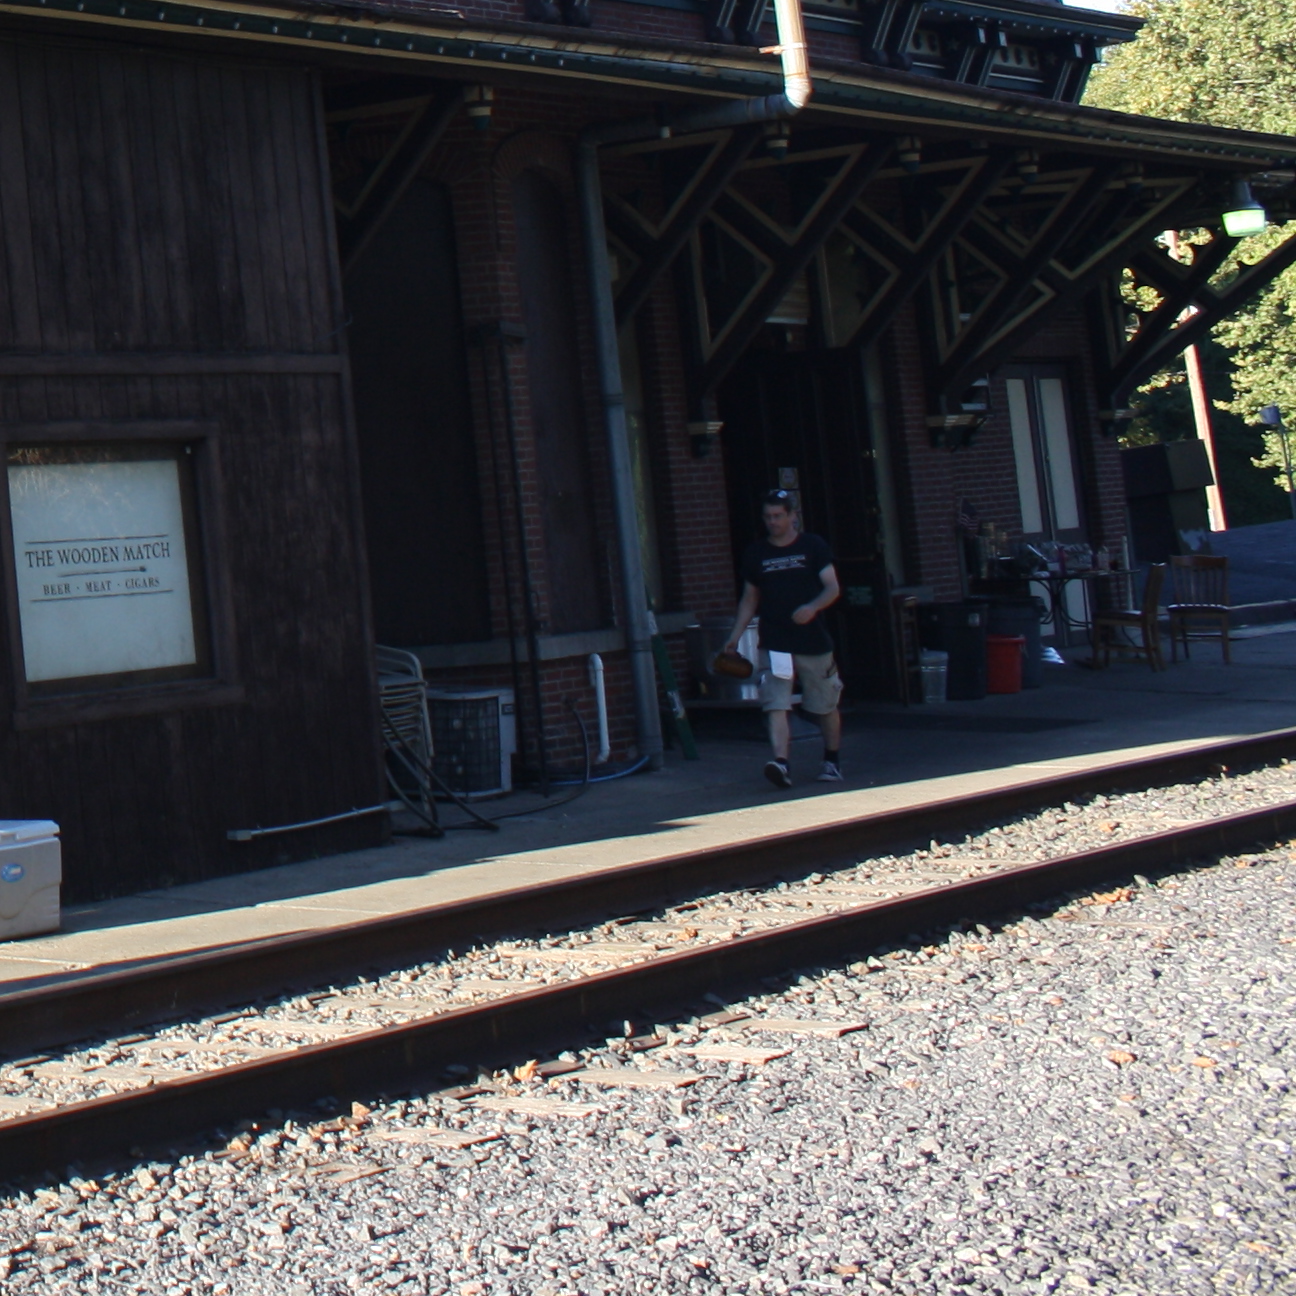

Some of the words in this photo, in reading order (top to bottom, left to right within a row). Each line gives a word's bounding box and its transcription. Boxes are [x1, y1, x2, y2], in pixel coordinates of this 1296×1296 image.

[25, 550, 55, 568] THE
[57, 546, 119, 564] WOODEN
[123, 542, 170, 562] MATCH
[43, 583, 70, 596] BEER
[85, 580, 111, 593] MEAT
[125, 577, 160, 589] CIGARS
